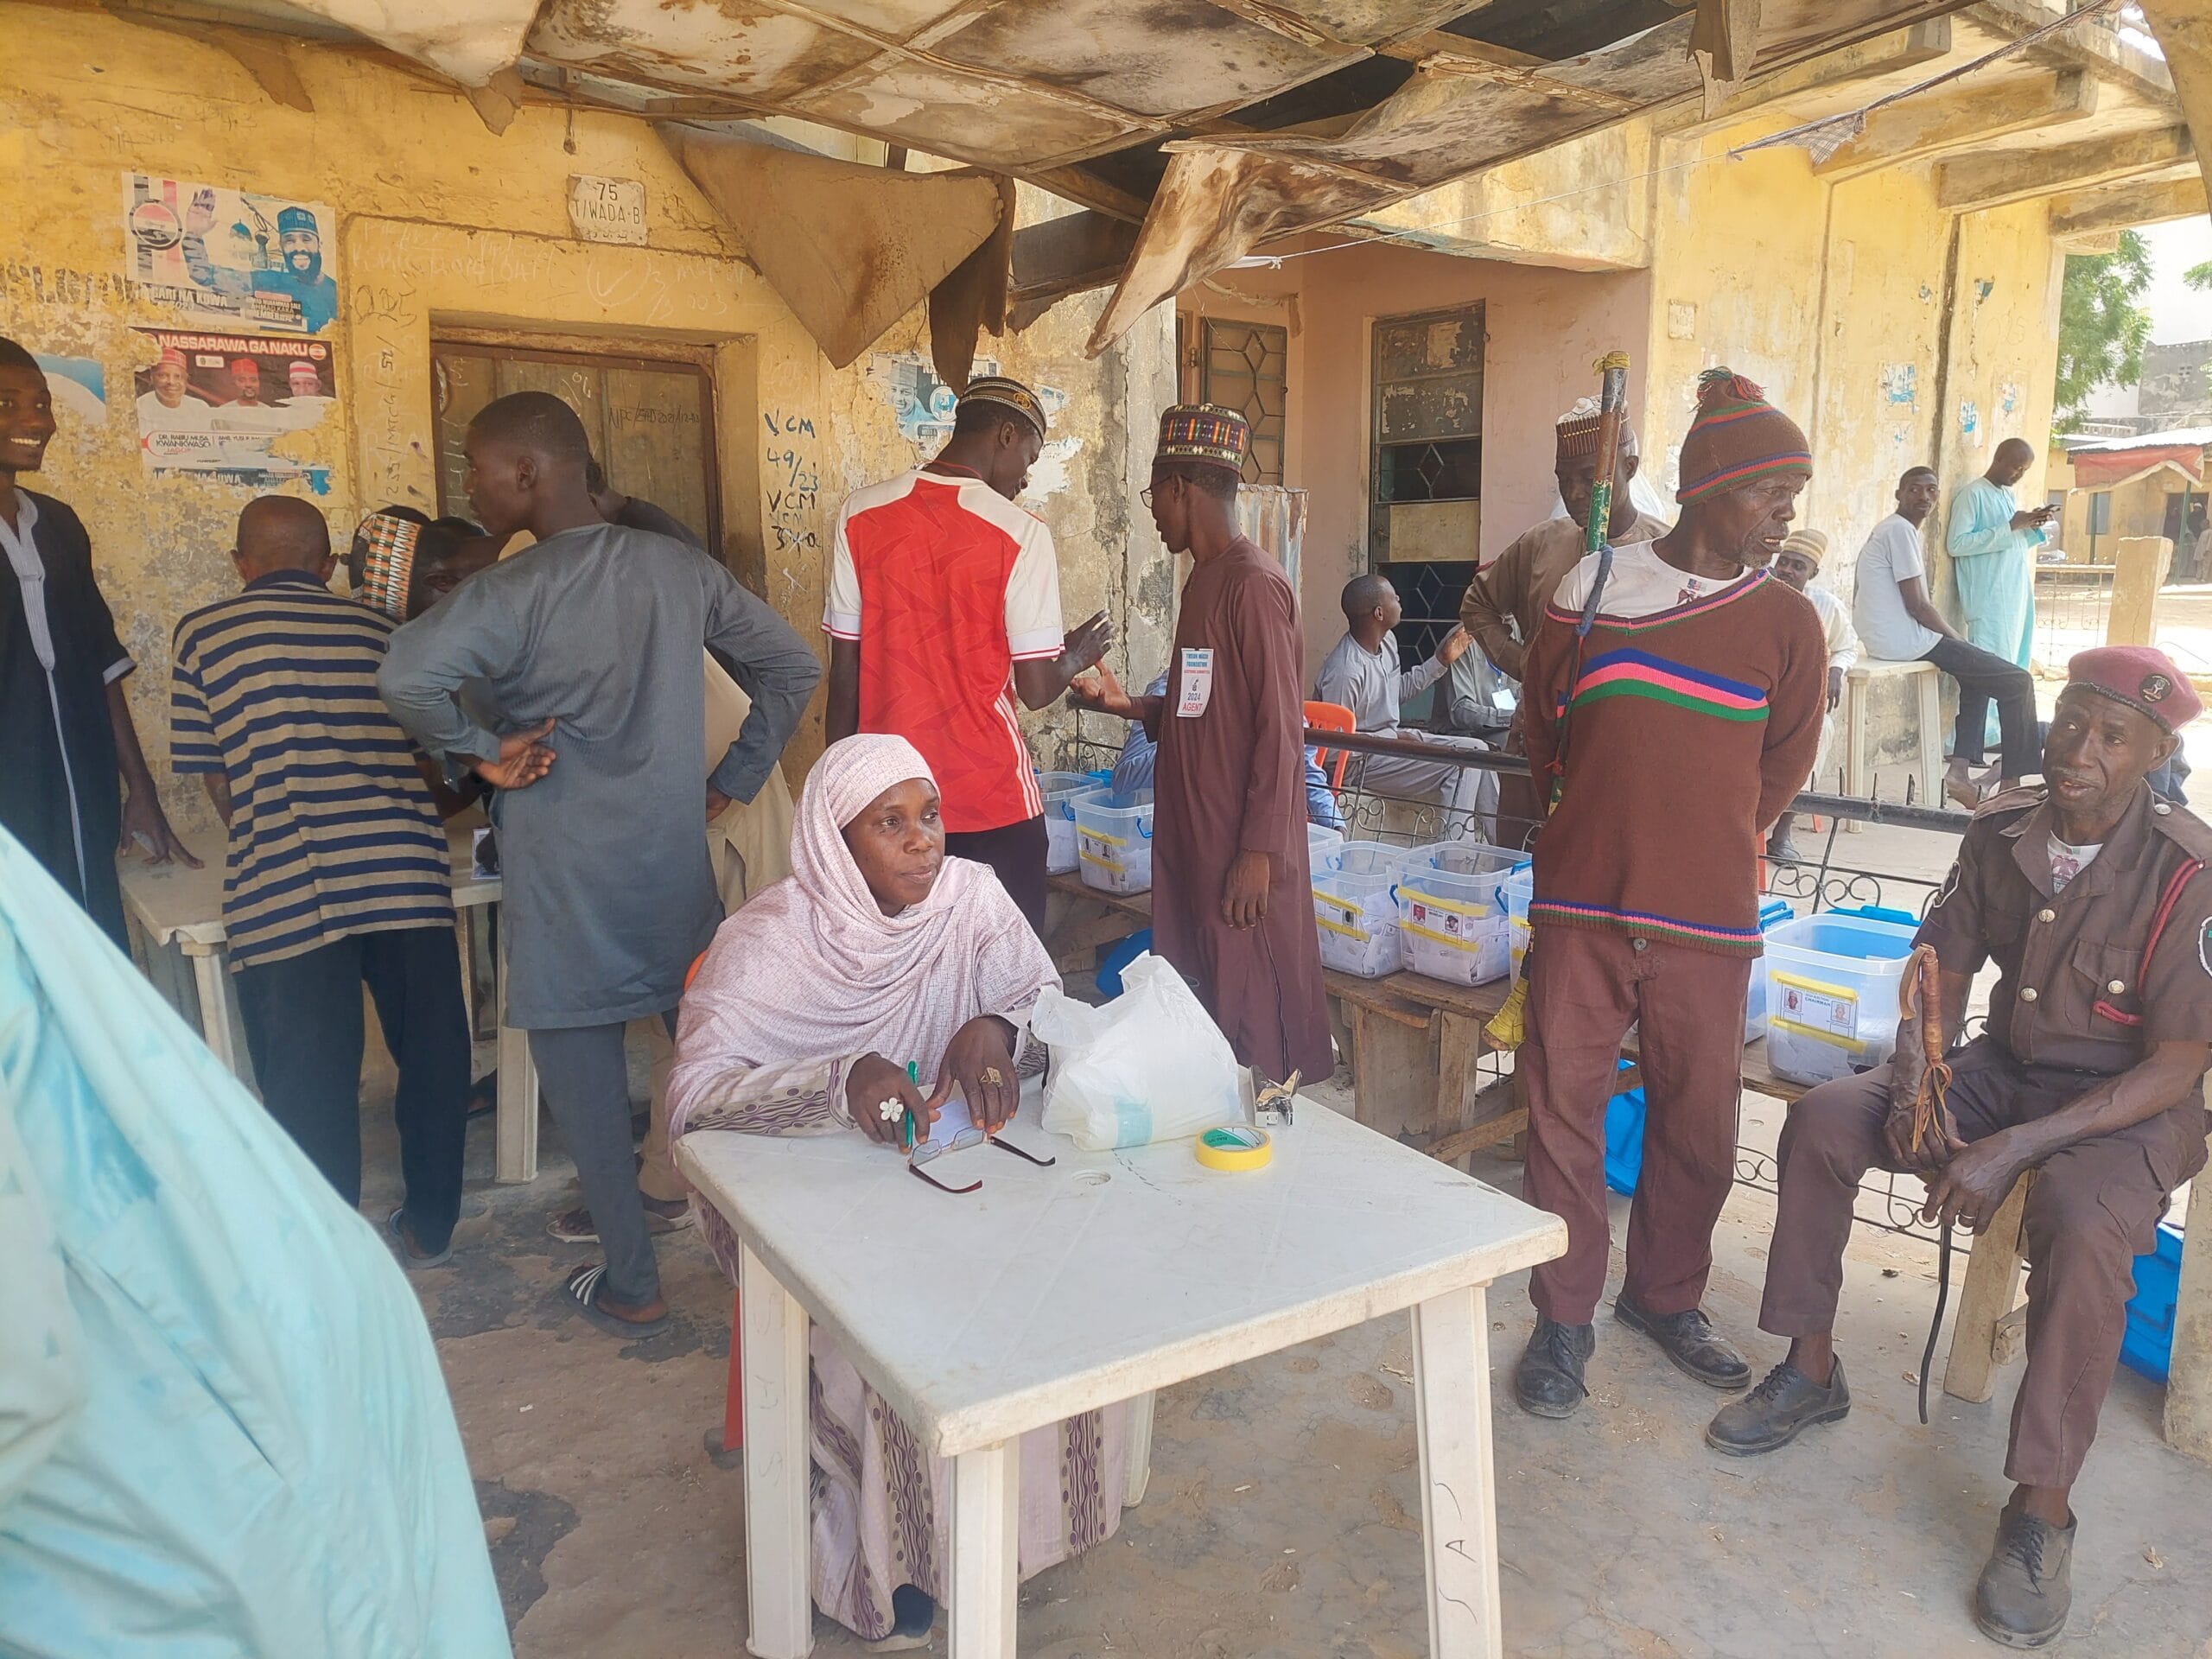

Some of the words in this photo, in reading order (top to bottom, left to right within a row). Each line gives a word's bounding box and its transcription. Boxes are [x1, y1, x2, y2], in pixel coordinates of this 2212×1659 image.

[596, 181, 619, 201] 75
[158, 334, 248, 353] NASSARAWA
[249, 340, 270, 354] GA
[270, 340, 308, 356] NAKU
[764, 408, 816, 439] VCM
[156, 440, 212, 448] KWANKWASO
[766, 489, 816, 513] VCM
[1182, 702, 1203, 712] AGENT
[1187, 692, 1201, 702] 2024
